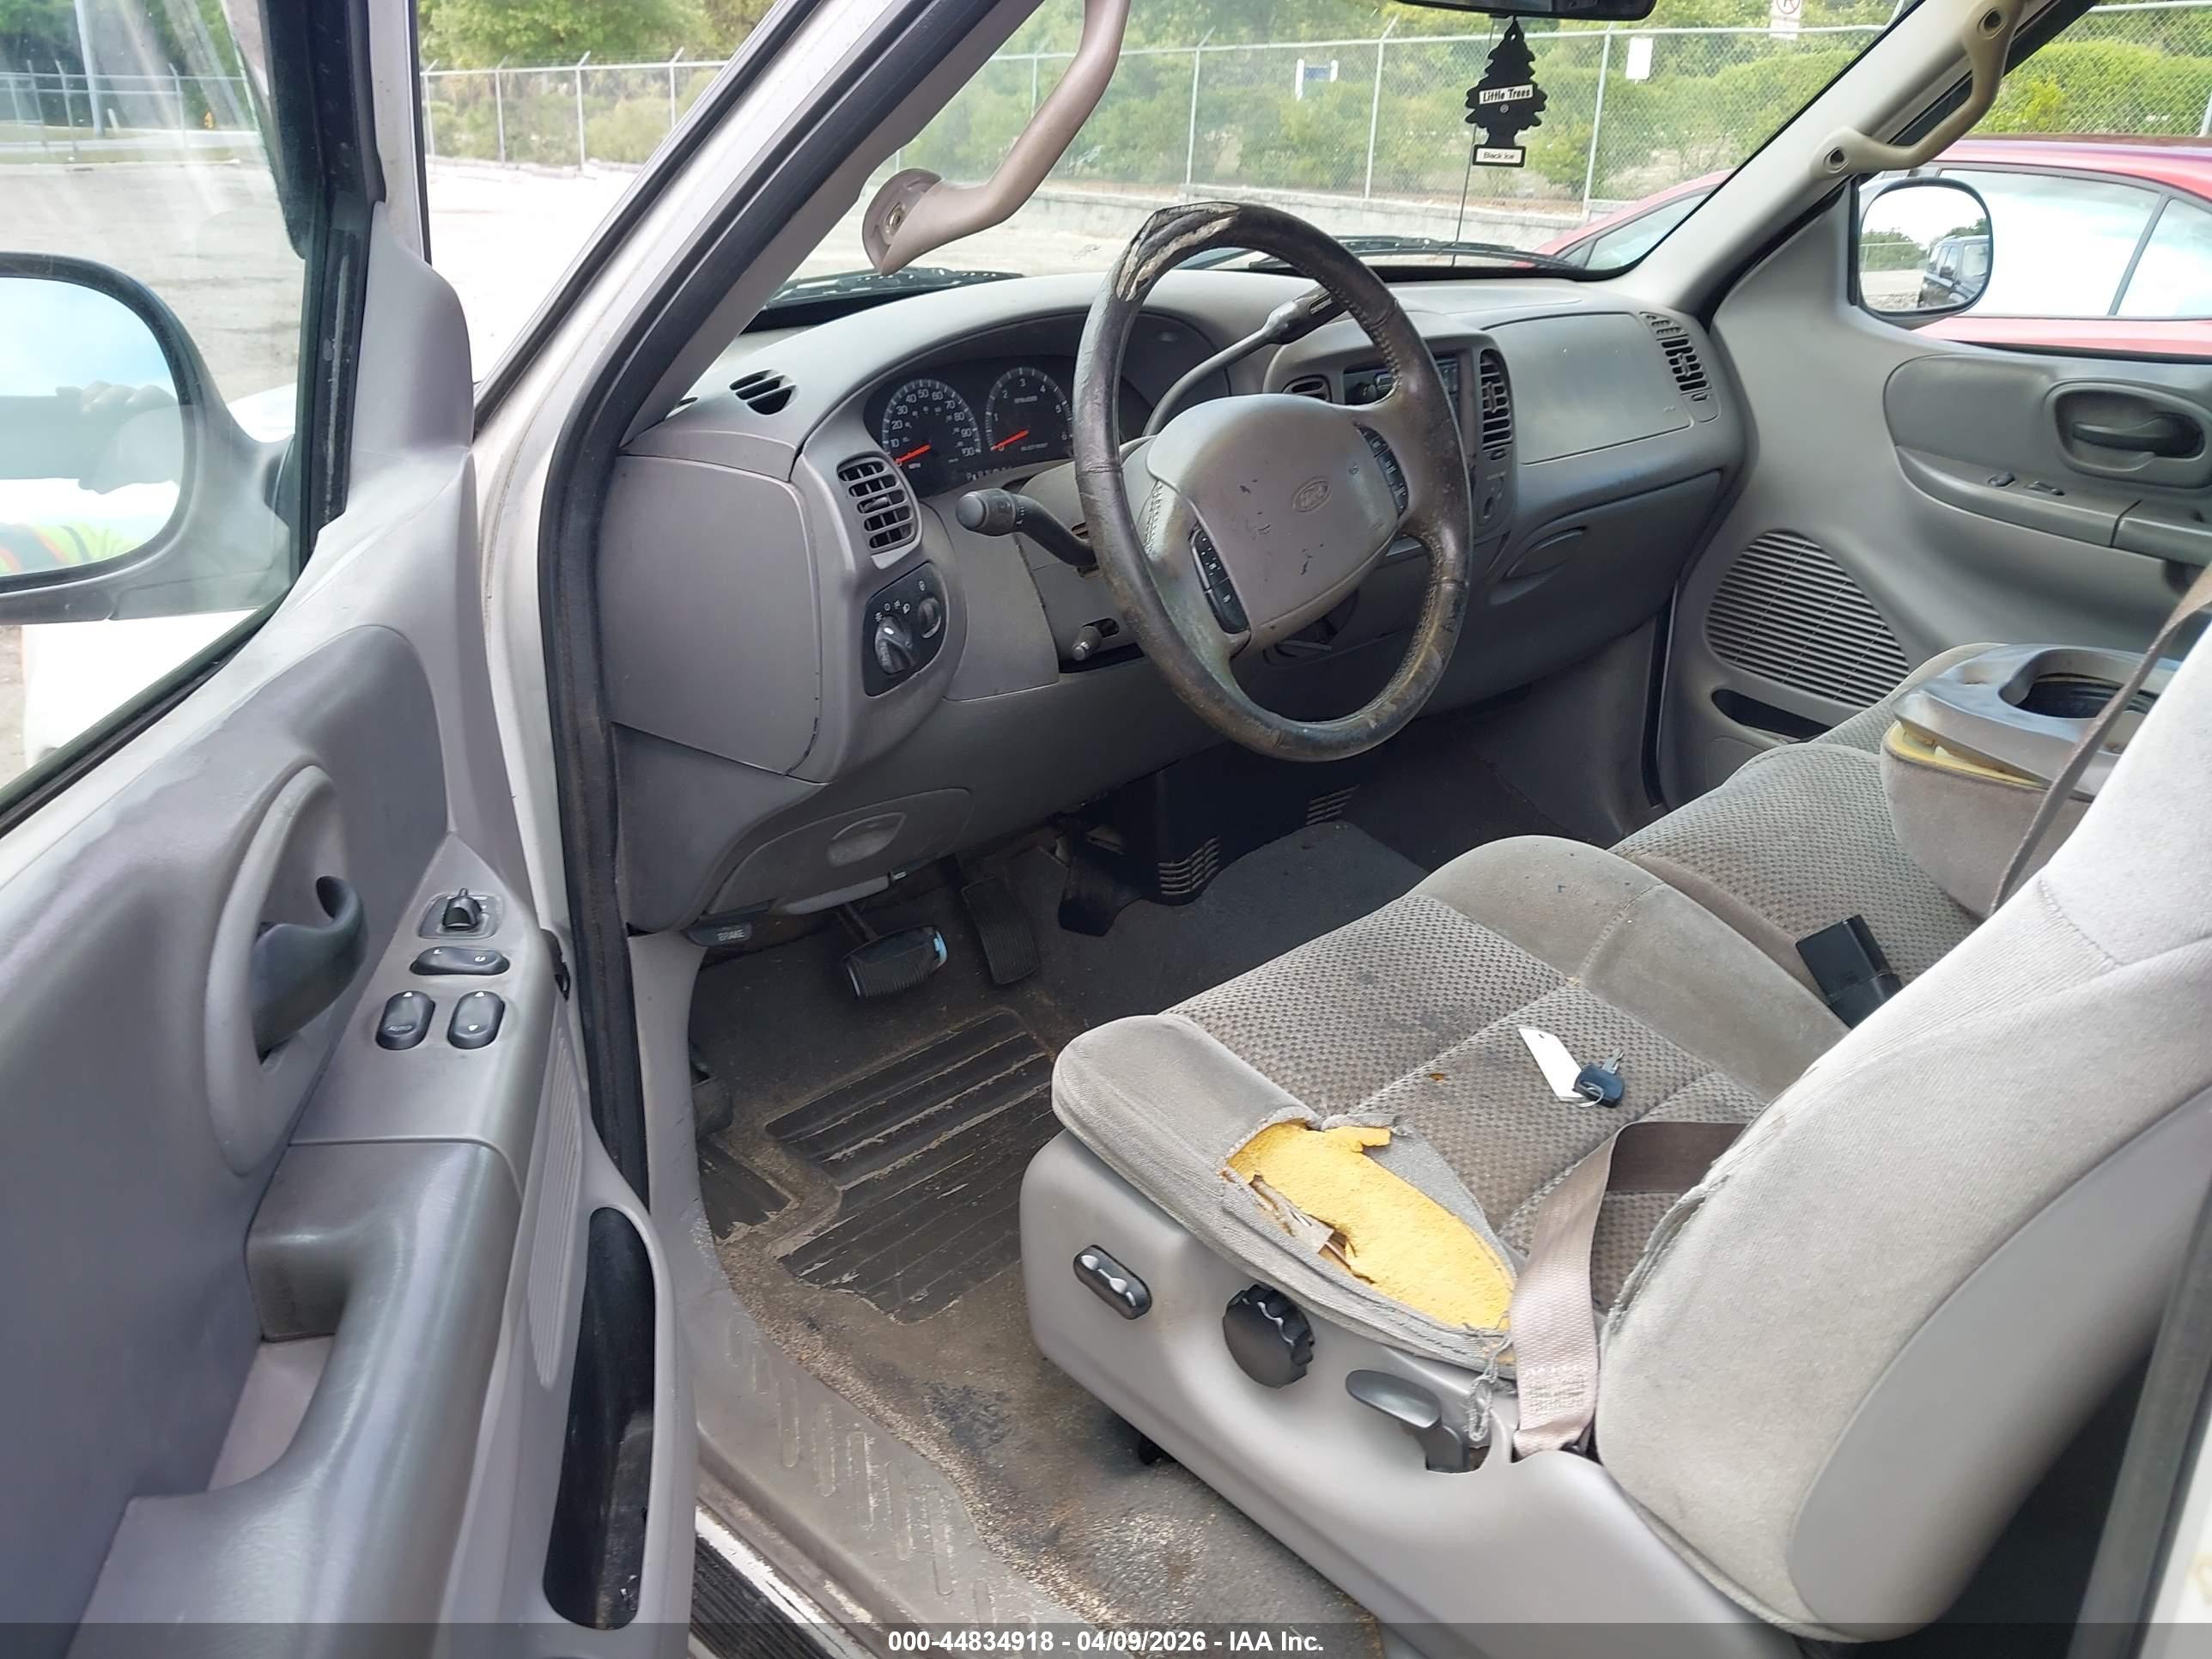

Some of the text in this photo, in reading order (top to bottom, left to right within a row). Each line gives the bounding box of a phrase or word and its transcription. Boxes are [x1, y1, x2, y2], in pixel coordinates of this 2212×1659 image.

[1483, 88, 1530, 102] Little Trees
[906, 393, 917, 404] 40
[917, 388, 929, 398] 50
[932, 391, 943, 401] 60
[896, 404, 908, 416] 30
[945, 399, 956, 410] 70
[953, 411, 965, 422] 80
[891, 419, 903, 429] 20
[890, 438, 900, 447] 10
